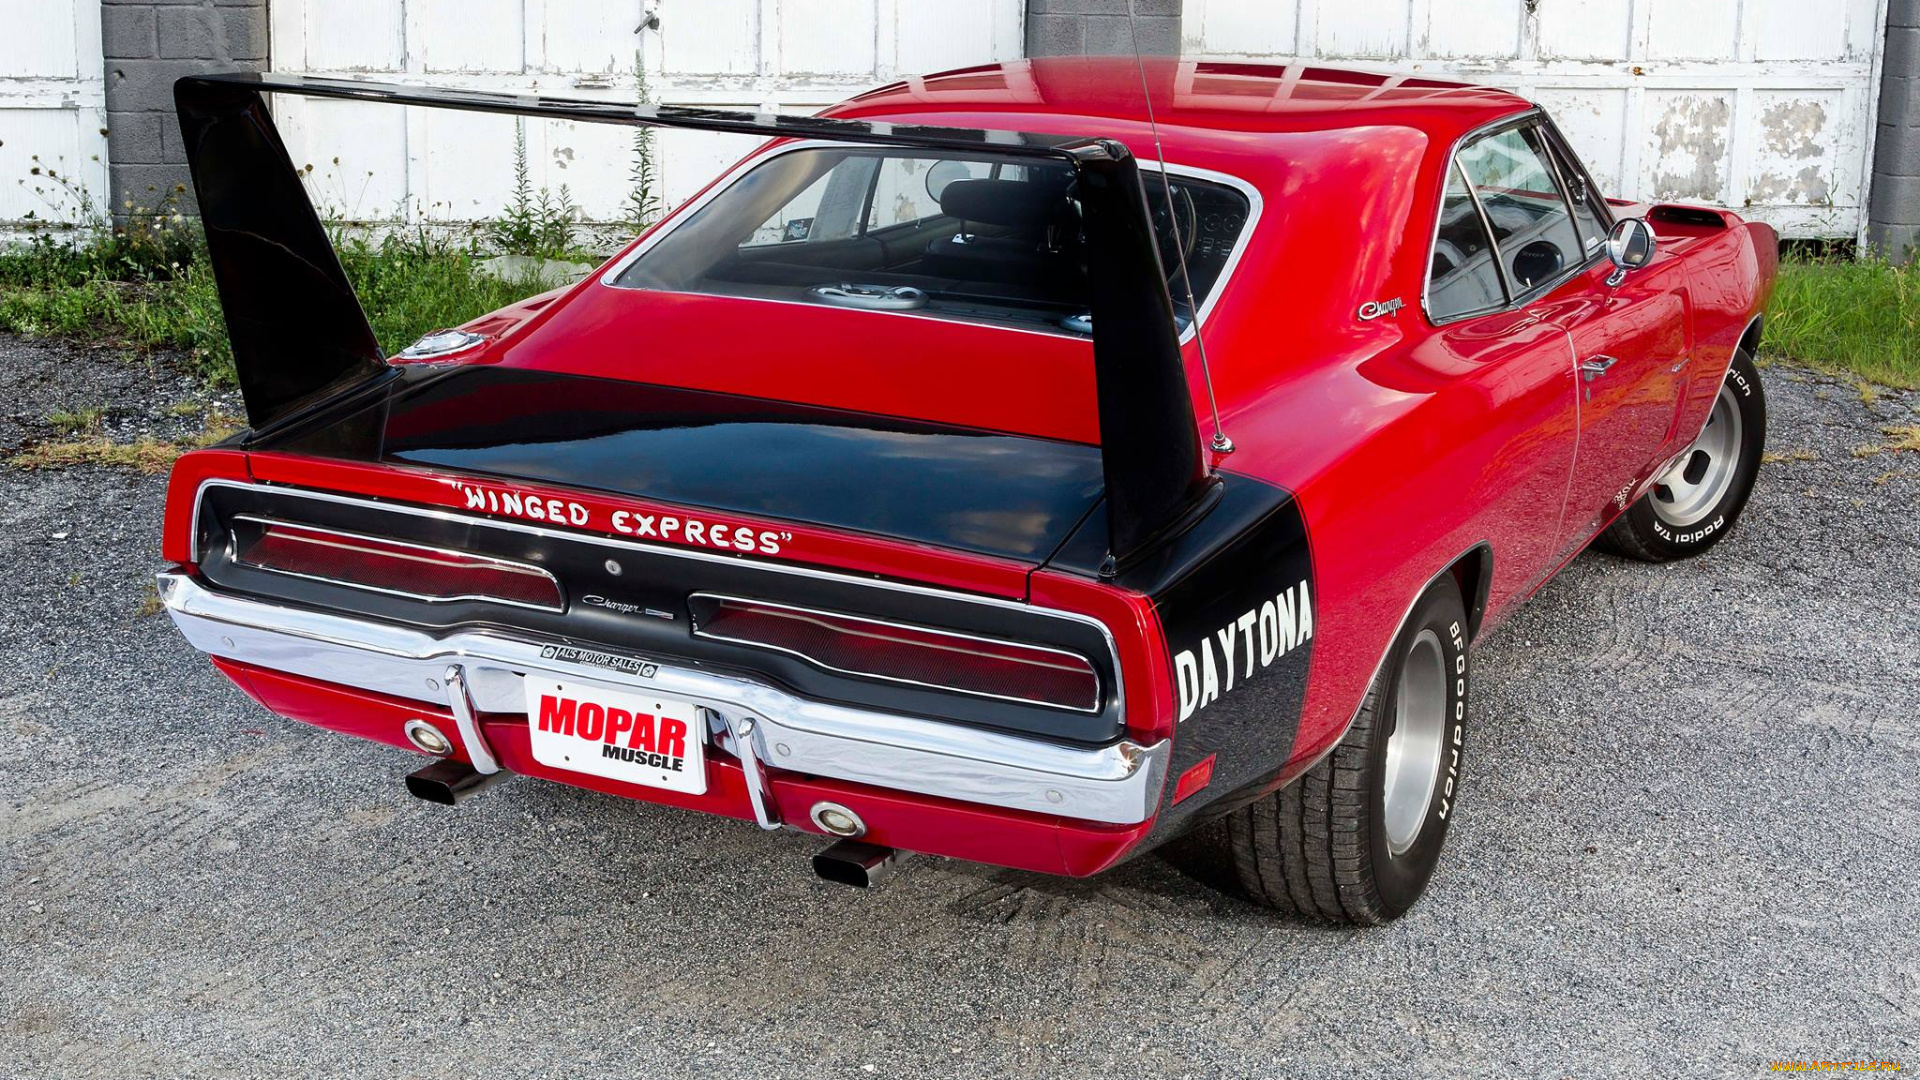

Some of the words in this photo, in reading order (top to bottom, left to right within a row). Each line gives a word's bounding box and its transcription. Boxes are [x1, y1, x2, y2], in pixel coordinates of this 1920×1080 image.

[1654, 520, 1672, 541] T/A
[1675, 515, 1725, 543] Radial
[582, 594, 642, 614] Charger
[558, 648, 578, 659] AL'S
[577, 651, 610, 666] MOTOR
[610, 657, 641, 671] SALES
[1174, 579, 1313, 723] DAYTONA
[538, 694, 688, 758] MOPAR
[1438, 621, 1466, 820] BFGoodrich
[602, 744, 684, 772] MUSCLE
